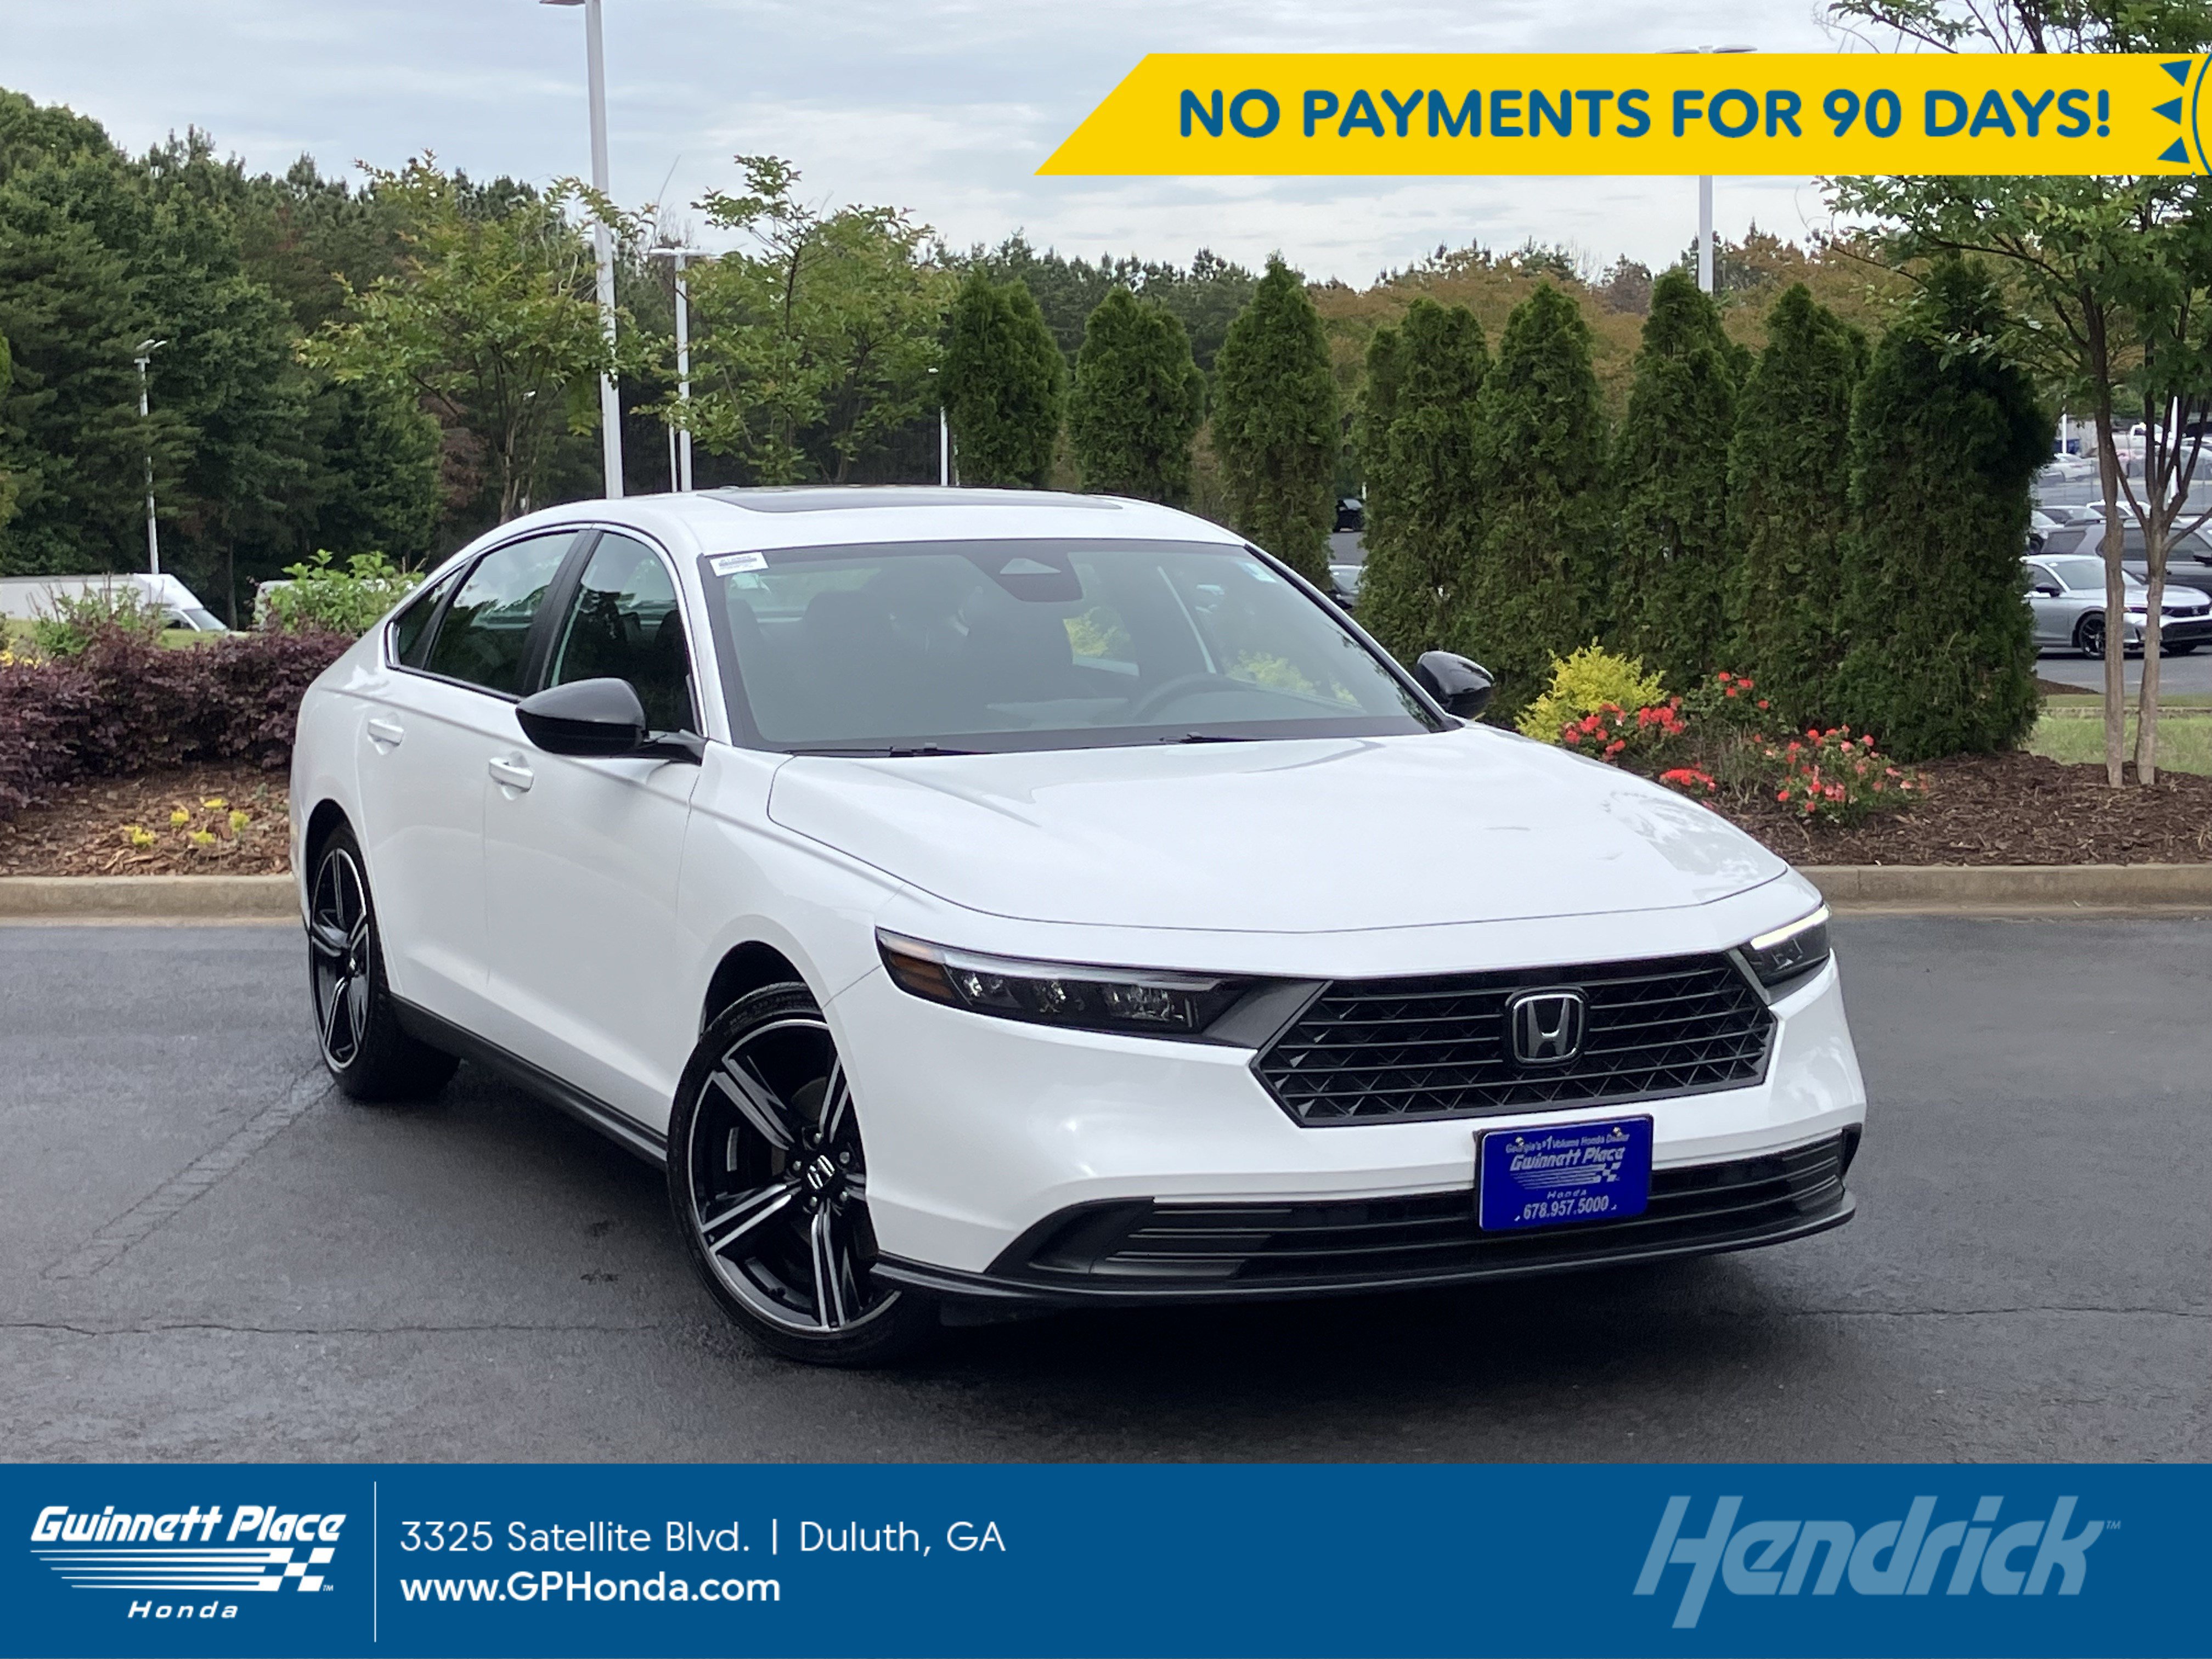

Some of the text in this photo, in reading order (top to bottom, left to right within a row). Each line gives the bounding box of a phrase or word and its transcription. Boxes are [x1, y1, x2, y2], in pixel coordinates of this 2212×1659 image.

[1581, 1135, 1605, 1146] Honda
[1509, 1147, 1626, 1171] Gwinnett Place
[1547, 1189, 1587, 1199] Honda
[1523, 1195, 1609, 1220] 678.957.5000
